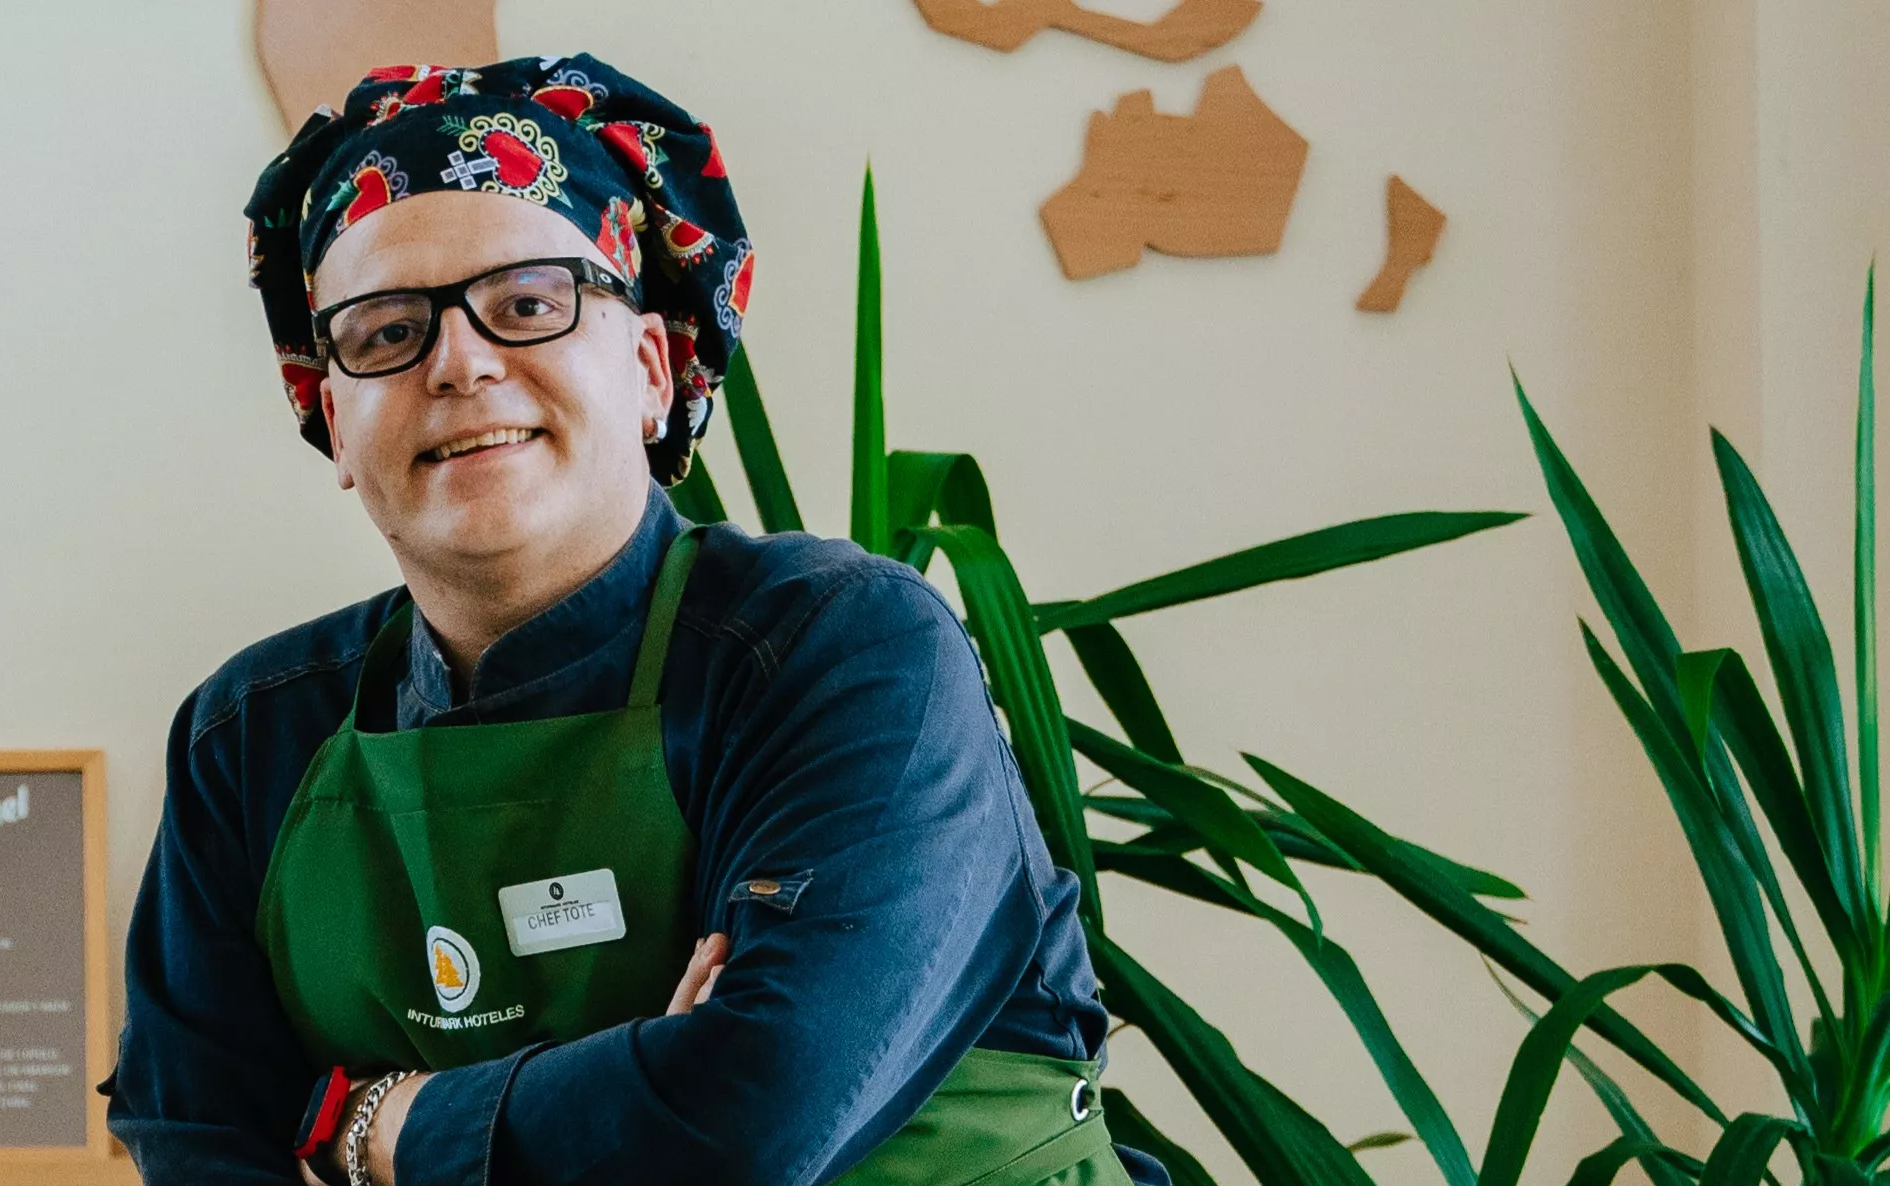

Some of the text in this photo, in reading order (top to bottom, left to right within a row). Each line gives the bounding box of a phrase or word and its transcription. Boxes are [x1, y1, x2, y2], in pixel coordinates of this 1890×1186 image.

[528, 910, 561, 930] CHEF
[562, 903, 595, 922] TOTE
[464, 1004, 525, 1028] HOTELES
